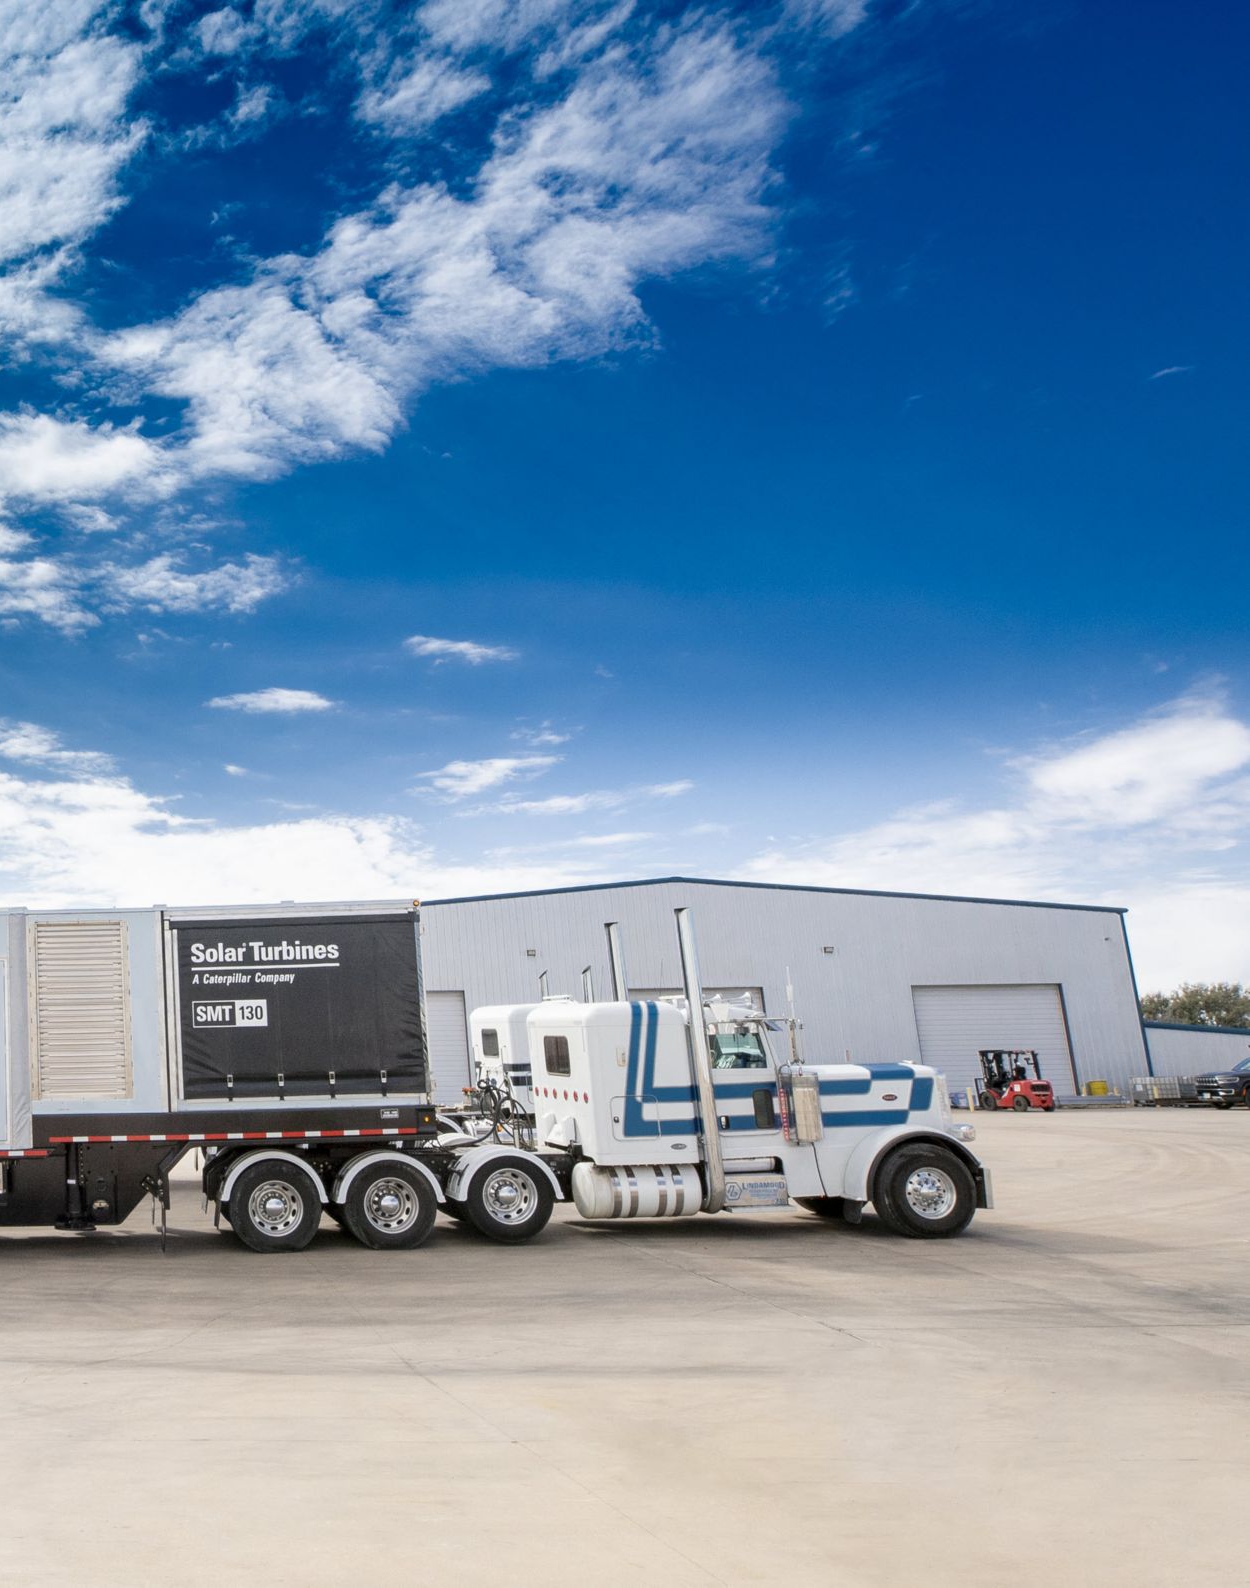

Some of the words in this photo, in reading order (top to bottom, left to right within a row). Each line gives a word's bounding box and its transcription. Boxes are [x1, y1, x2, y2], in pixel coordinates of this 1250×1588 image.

[249, 940, 339, 961] Turbines
[192, 974, 200, 984] A
[203, 973, 251, 986] Caterpillar
[255, 972, 295, 984] Company
[196, 1005, 232, 1022] SMT
[239, 1005, 264, 1020] 130
